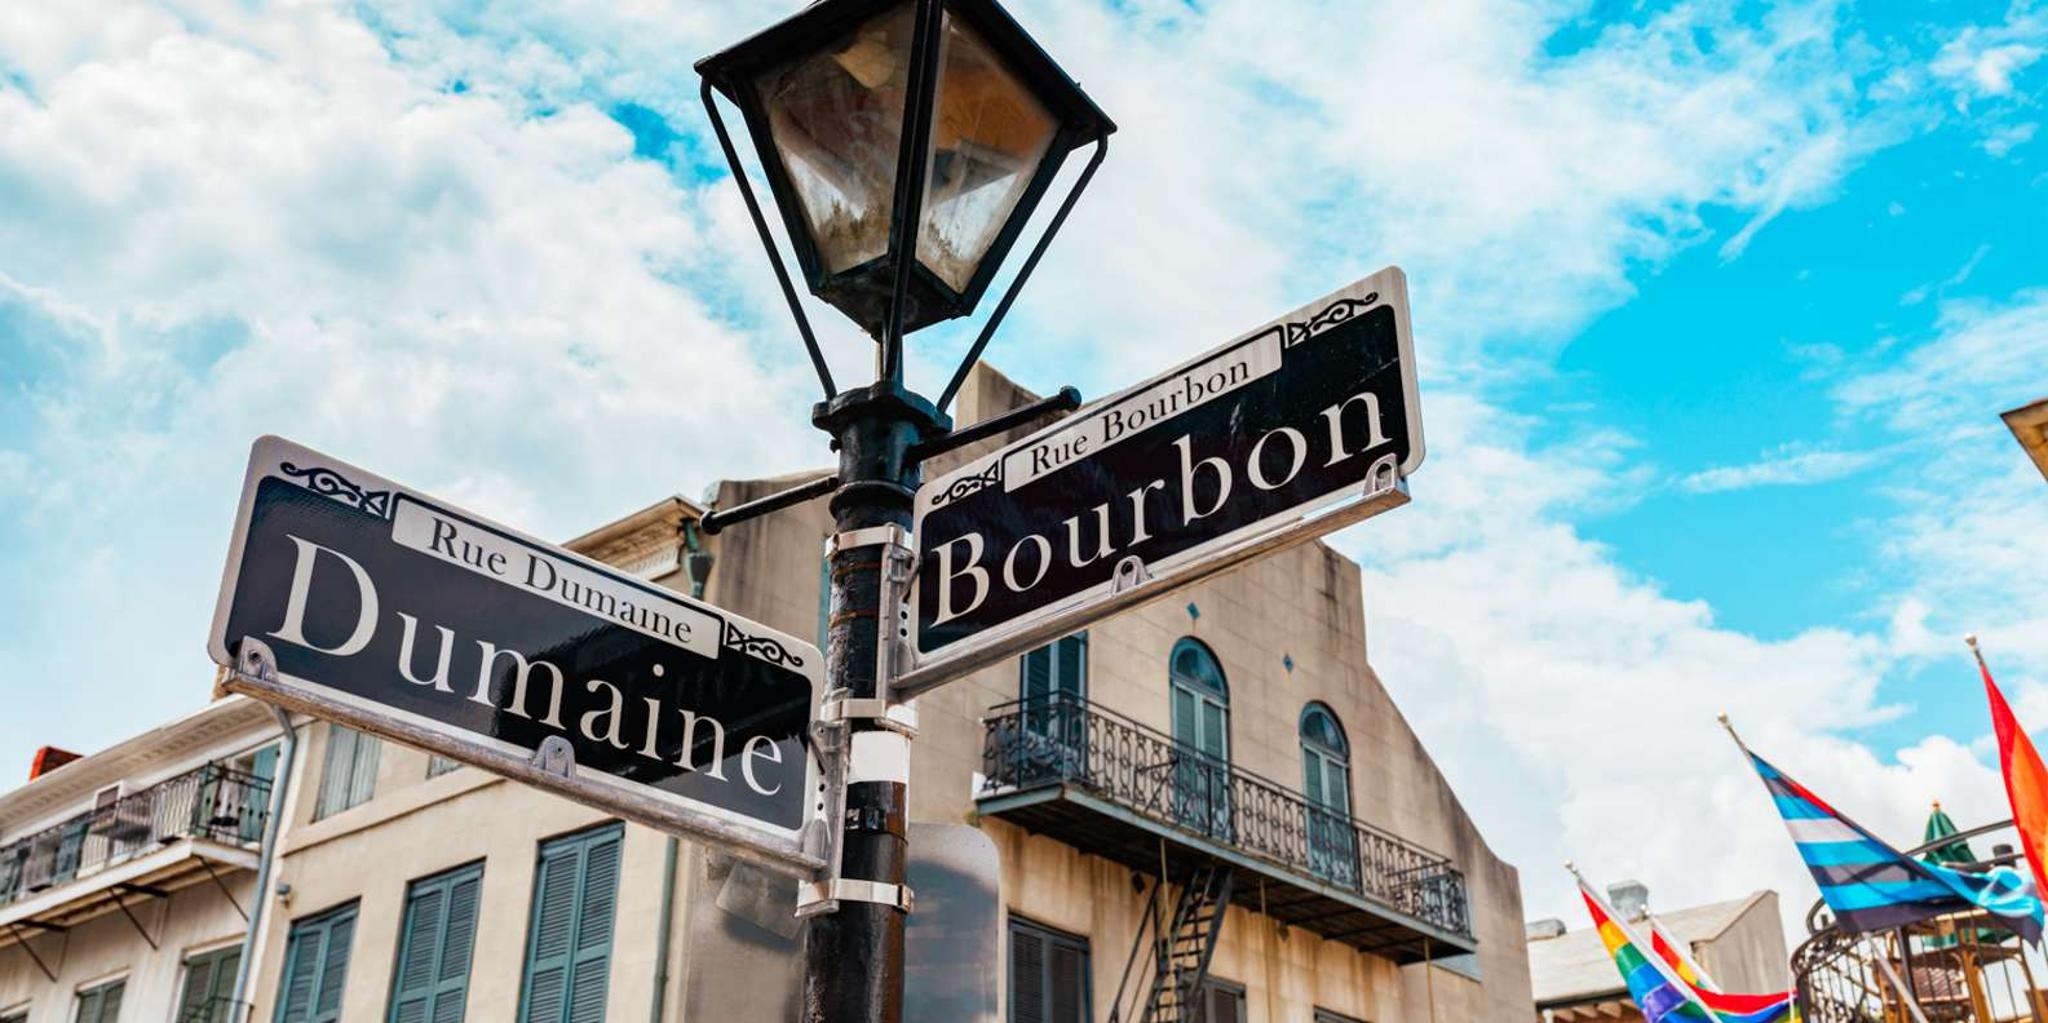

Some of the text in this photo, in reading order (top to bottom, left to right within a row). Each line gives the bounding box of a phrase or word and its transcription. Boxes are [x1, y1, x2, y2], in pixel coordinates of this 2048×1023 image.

[1030, 357, 1250, 476] Rue Bourbon
[430, 517, 693, 645] Rue Dumaine
[929, 391, 1392, 628] Bourbon
[266, 534, 784, 797] Dumaine
